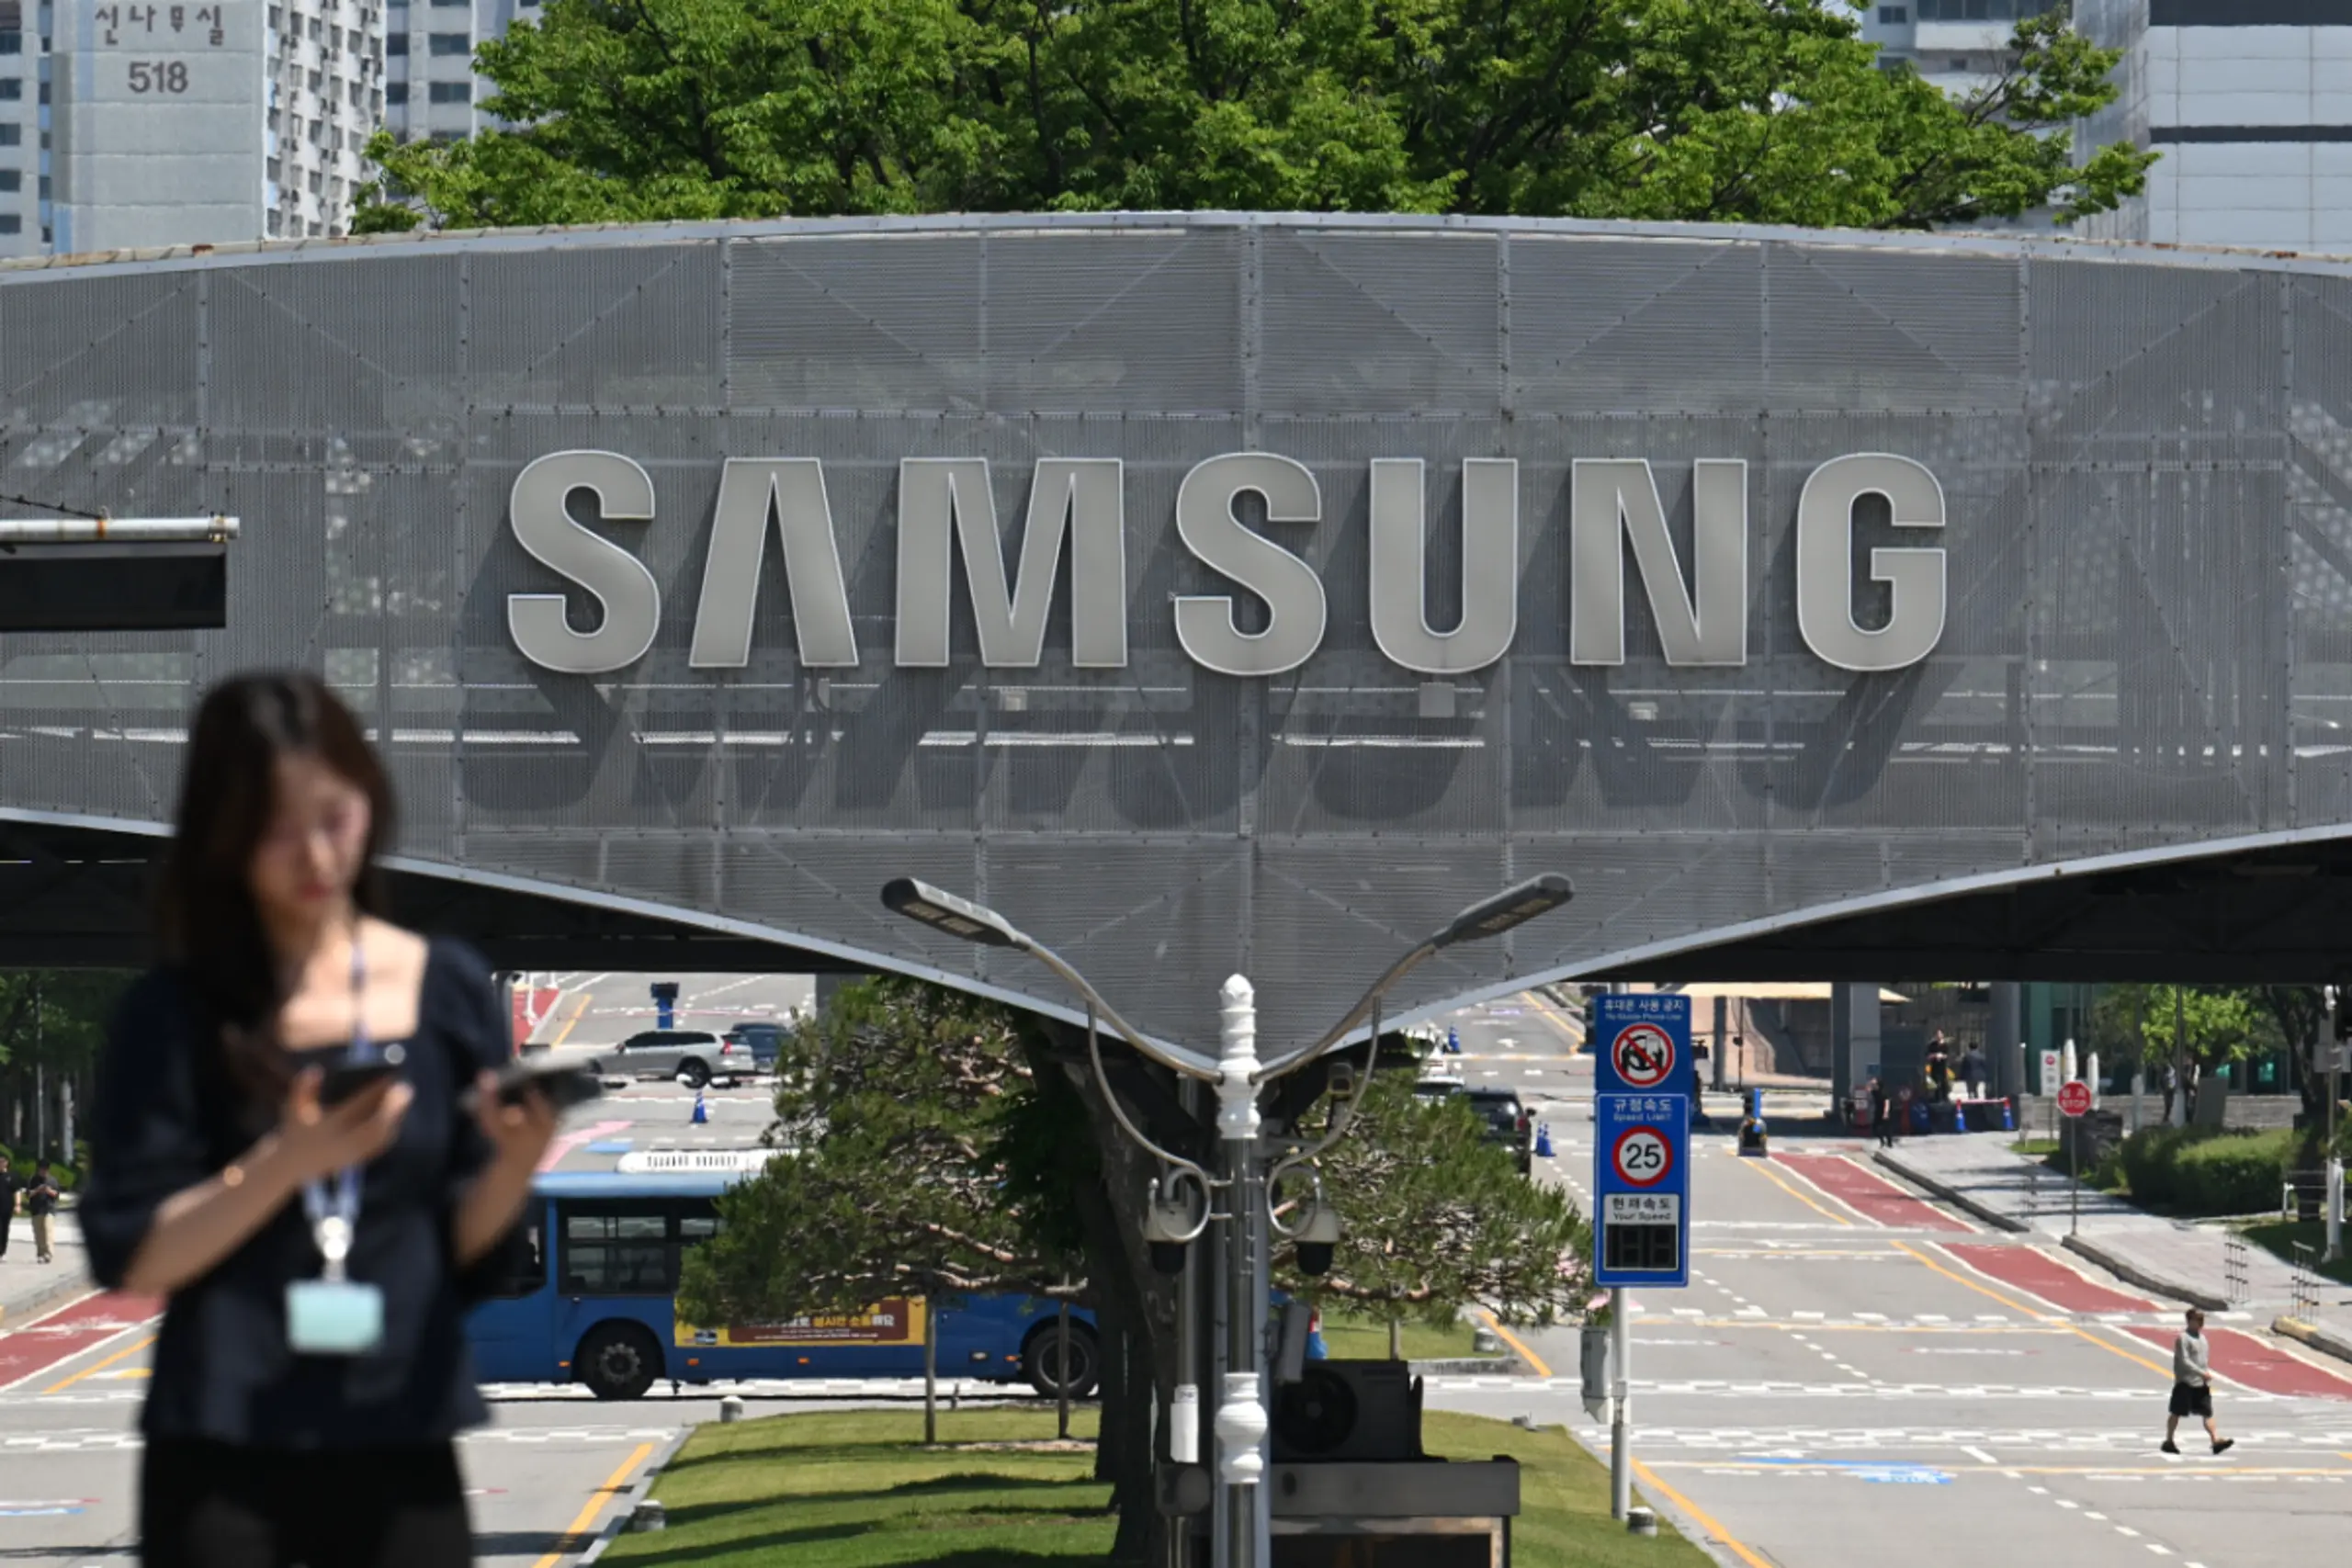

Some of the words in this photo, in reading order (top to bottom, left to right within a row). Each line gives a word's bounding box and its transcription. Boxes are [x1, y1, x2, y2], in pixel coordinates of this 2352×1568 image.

[95, 5, 224, 46] 신나무실
[128, 61, 188, 94] 518
[507, 449, 1946, 675] SAMSUNG
[1639, 998, 1659, 1012] 사용
[2062, 1100, 2086, 1109] STOP
[1626, 1143, 1661, 1168] 25
[1638, 1213, 1671, 1221] Speed
